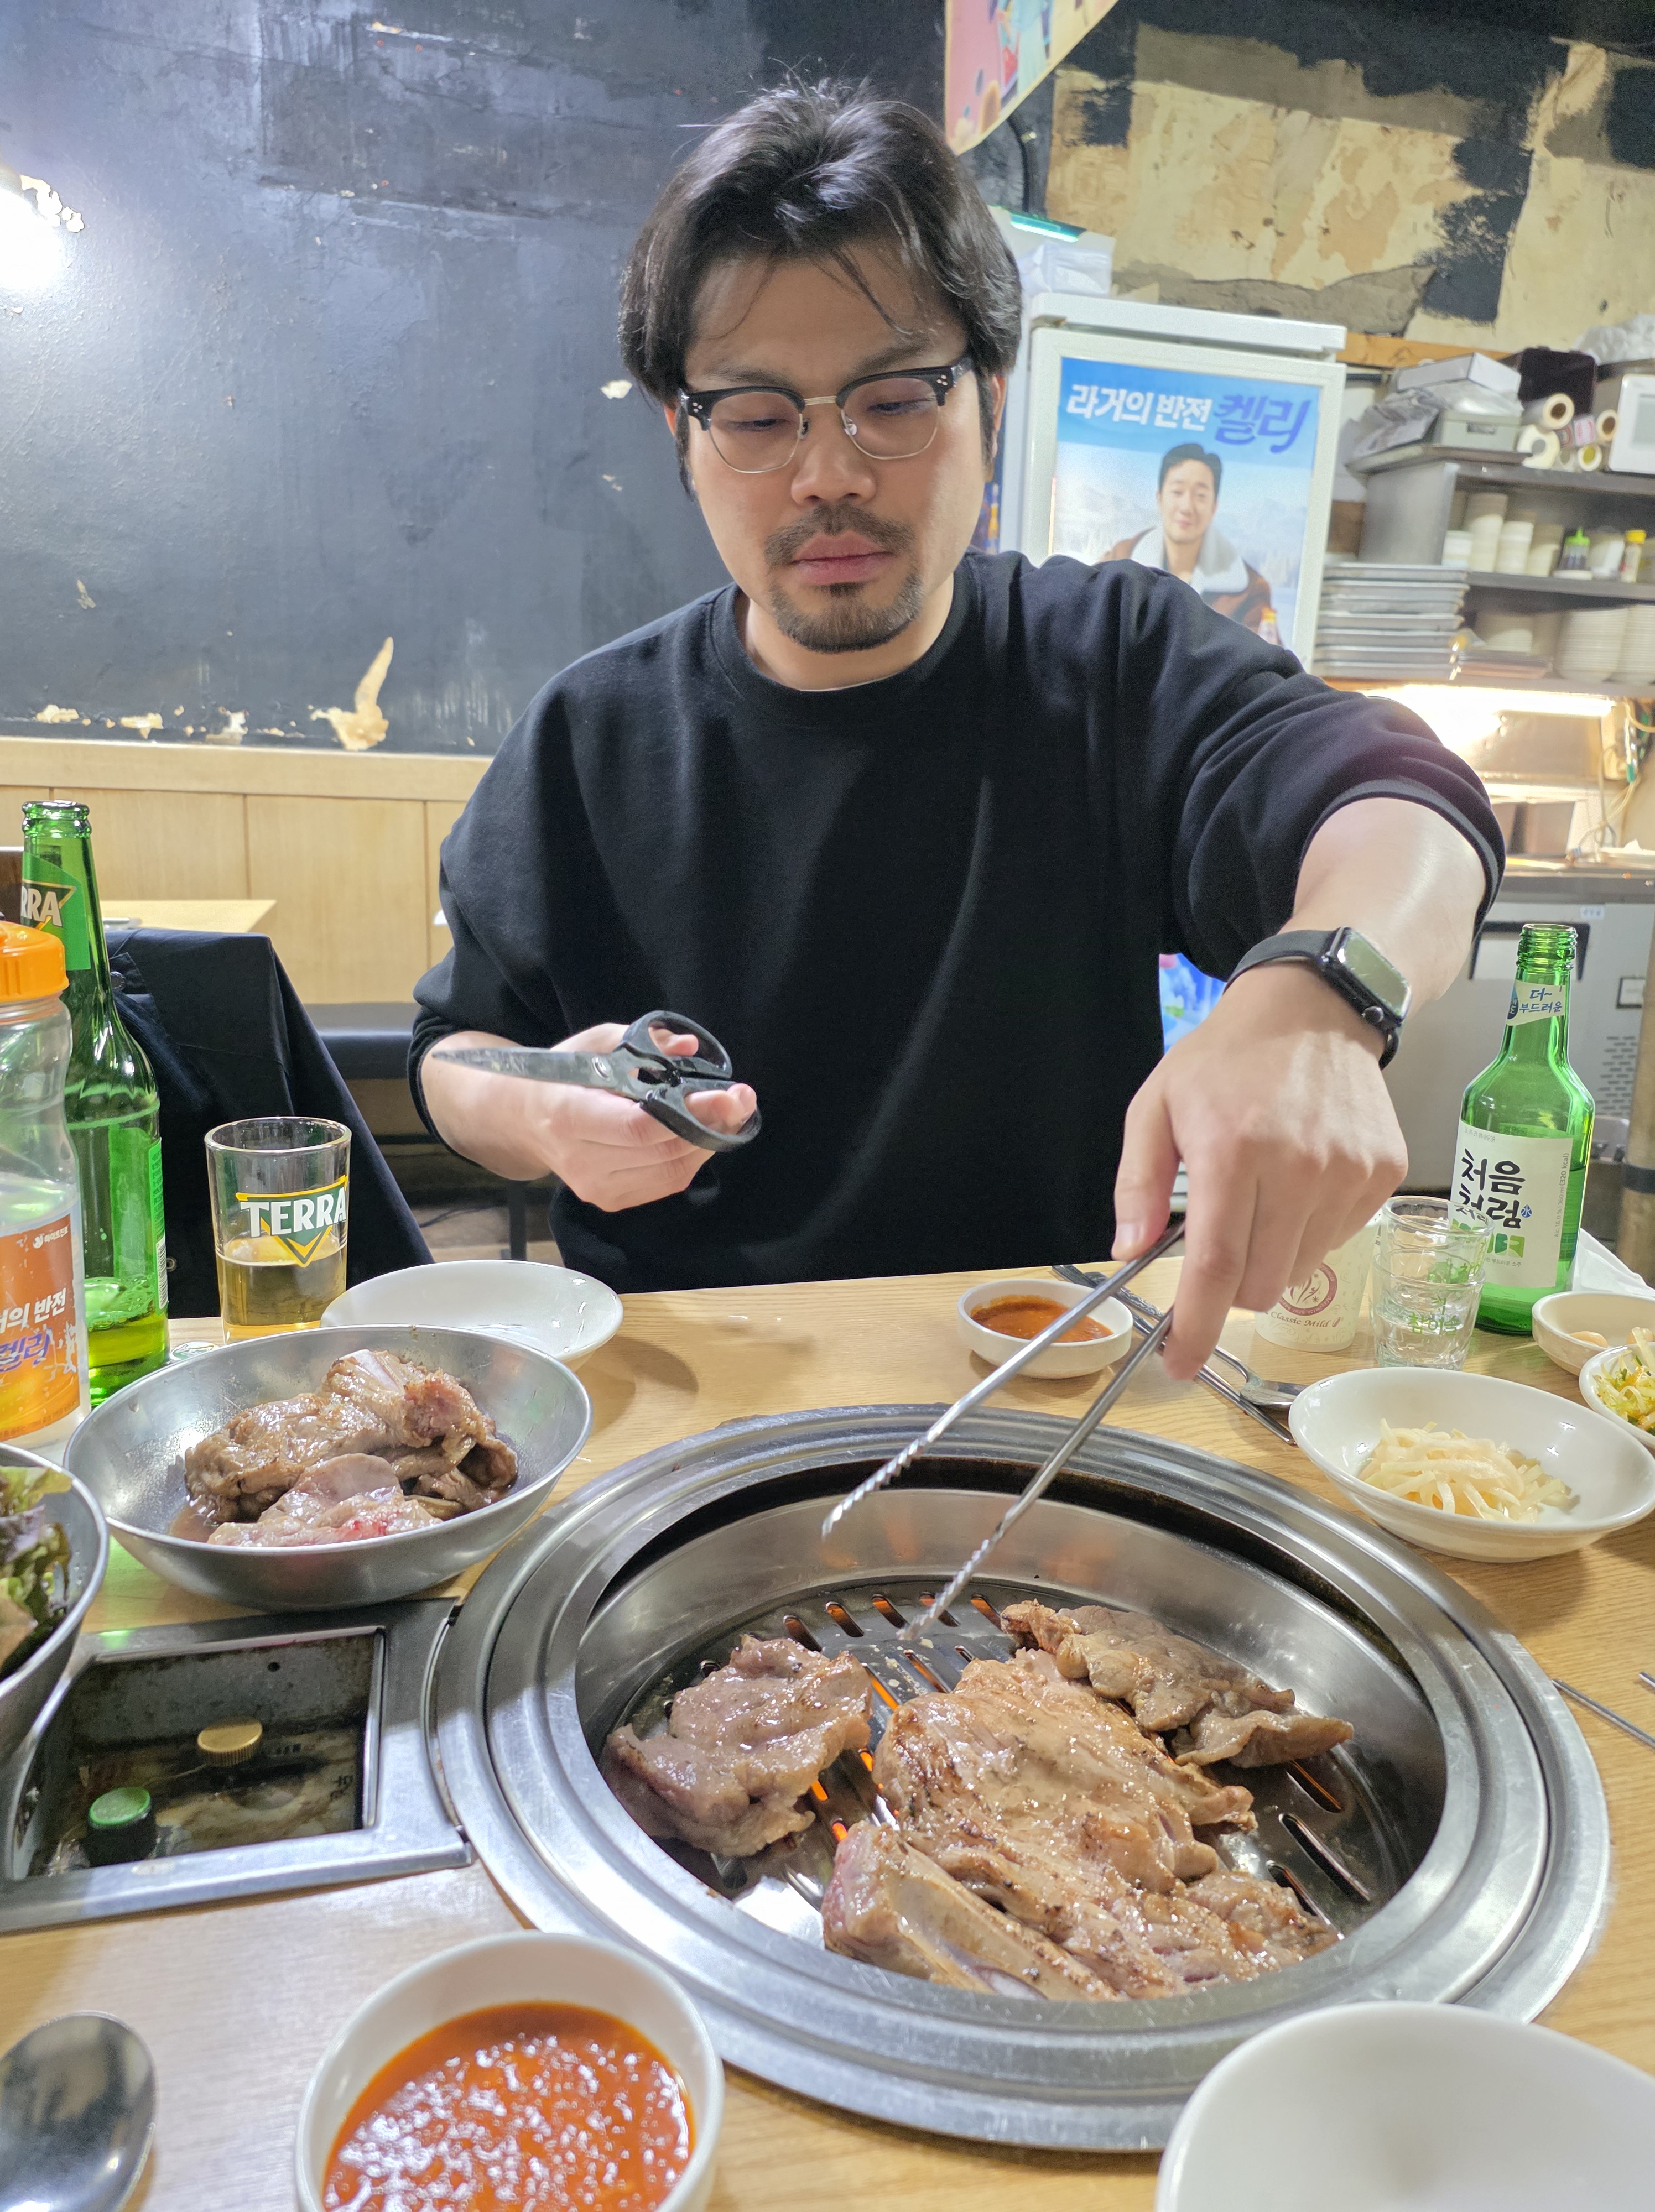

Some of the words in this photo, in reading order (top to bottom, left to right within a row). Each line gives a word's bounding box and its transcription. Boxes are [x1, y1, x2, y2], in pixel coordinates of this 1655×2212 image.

[1066, 384, 1154, 425] 라거의
[1154, 394, 1212, 432] 반전
[1214, 394, 1311, 453] 켈리
[21, 886, 63, 927] RRA
[1519, 1001, 1563, 1014] 부드러운
[1461, 1147, 1526, 1195] 처음
[240, 1186, 347, 1238] TERRA
[1456, 1183, 1522, 1229] 처럼
[34, 1287, 66, 1323] 반전
[1271, 1311, 1302, 1325] Classic
[1304, 1319, 1332, 1328] Mild
